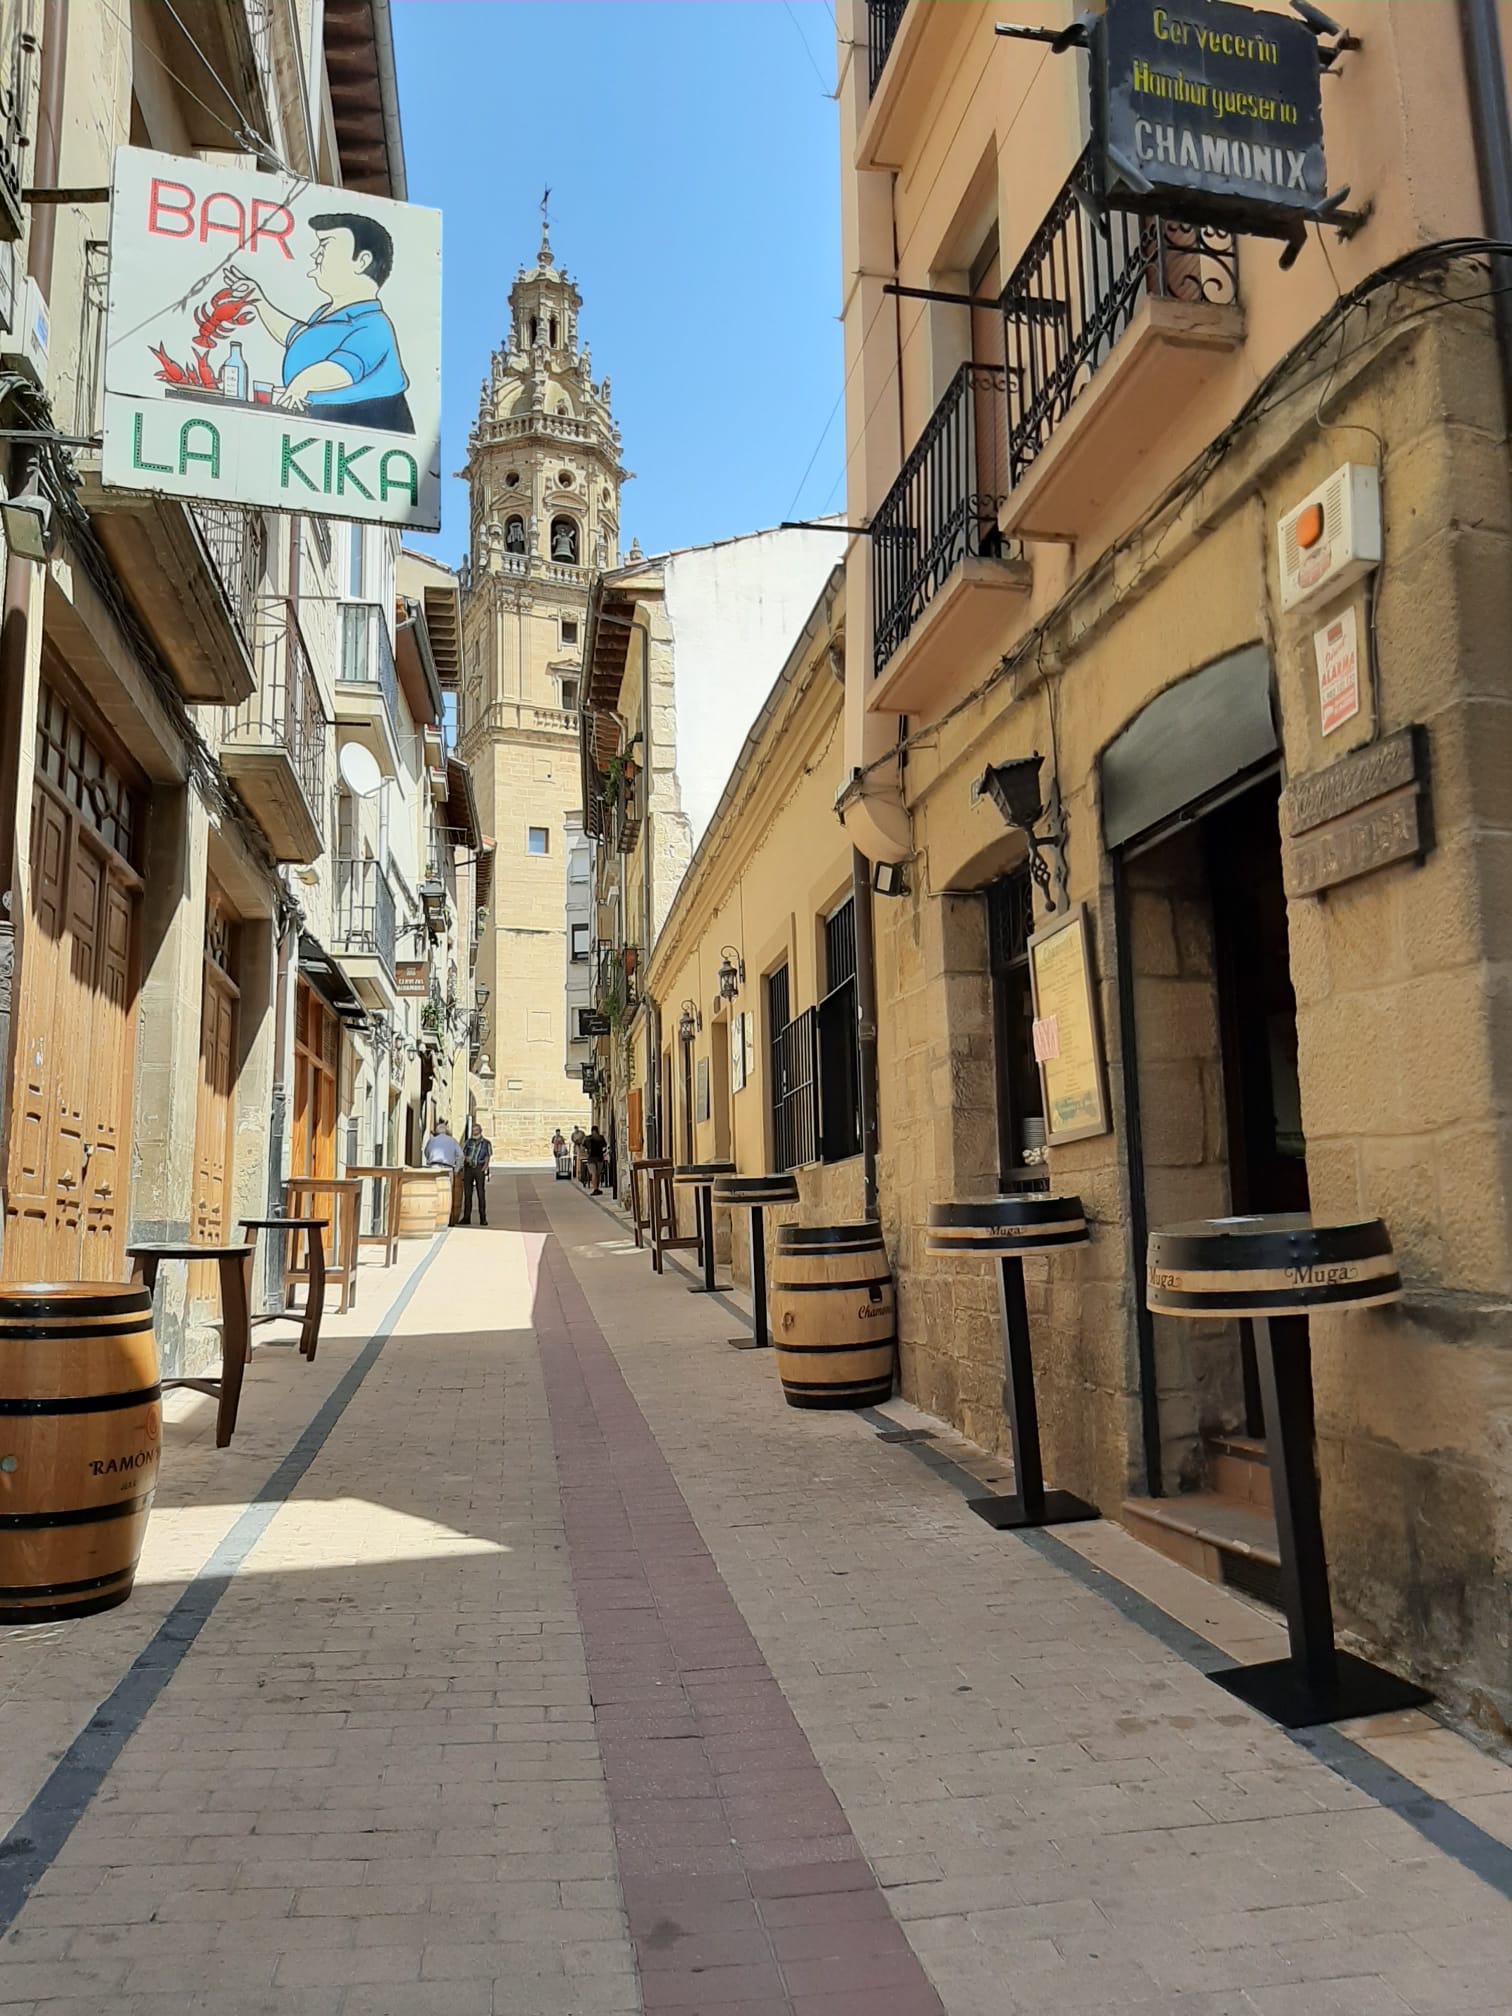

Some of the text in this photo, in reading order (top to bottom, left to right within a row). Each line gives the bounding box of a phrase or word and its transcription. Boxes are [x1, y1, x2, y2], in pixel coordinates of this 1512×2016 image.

[1134, 118, 1308, 191] CHAMONIX
[147, 177, 296, 261] BAR
[132, 411, 419, 507] LA KIKA
[991, 1225, 1022, 1237] Muga
[1149, 1265, 1175, 1289] Muga
[1291, 1266, 1350, 1286] Muga
[88, 1448, 154, 1476] RAMÓN
